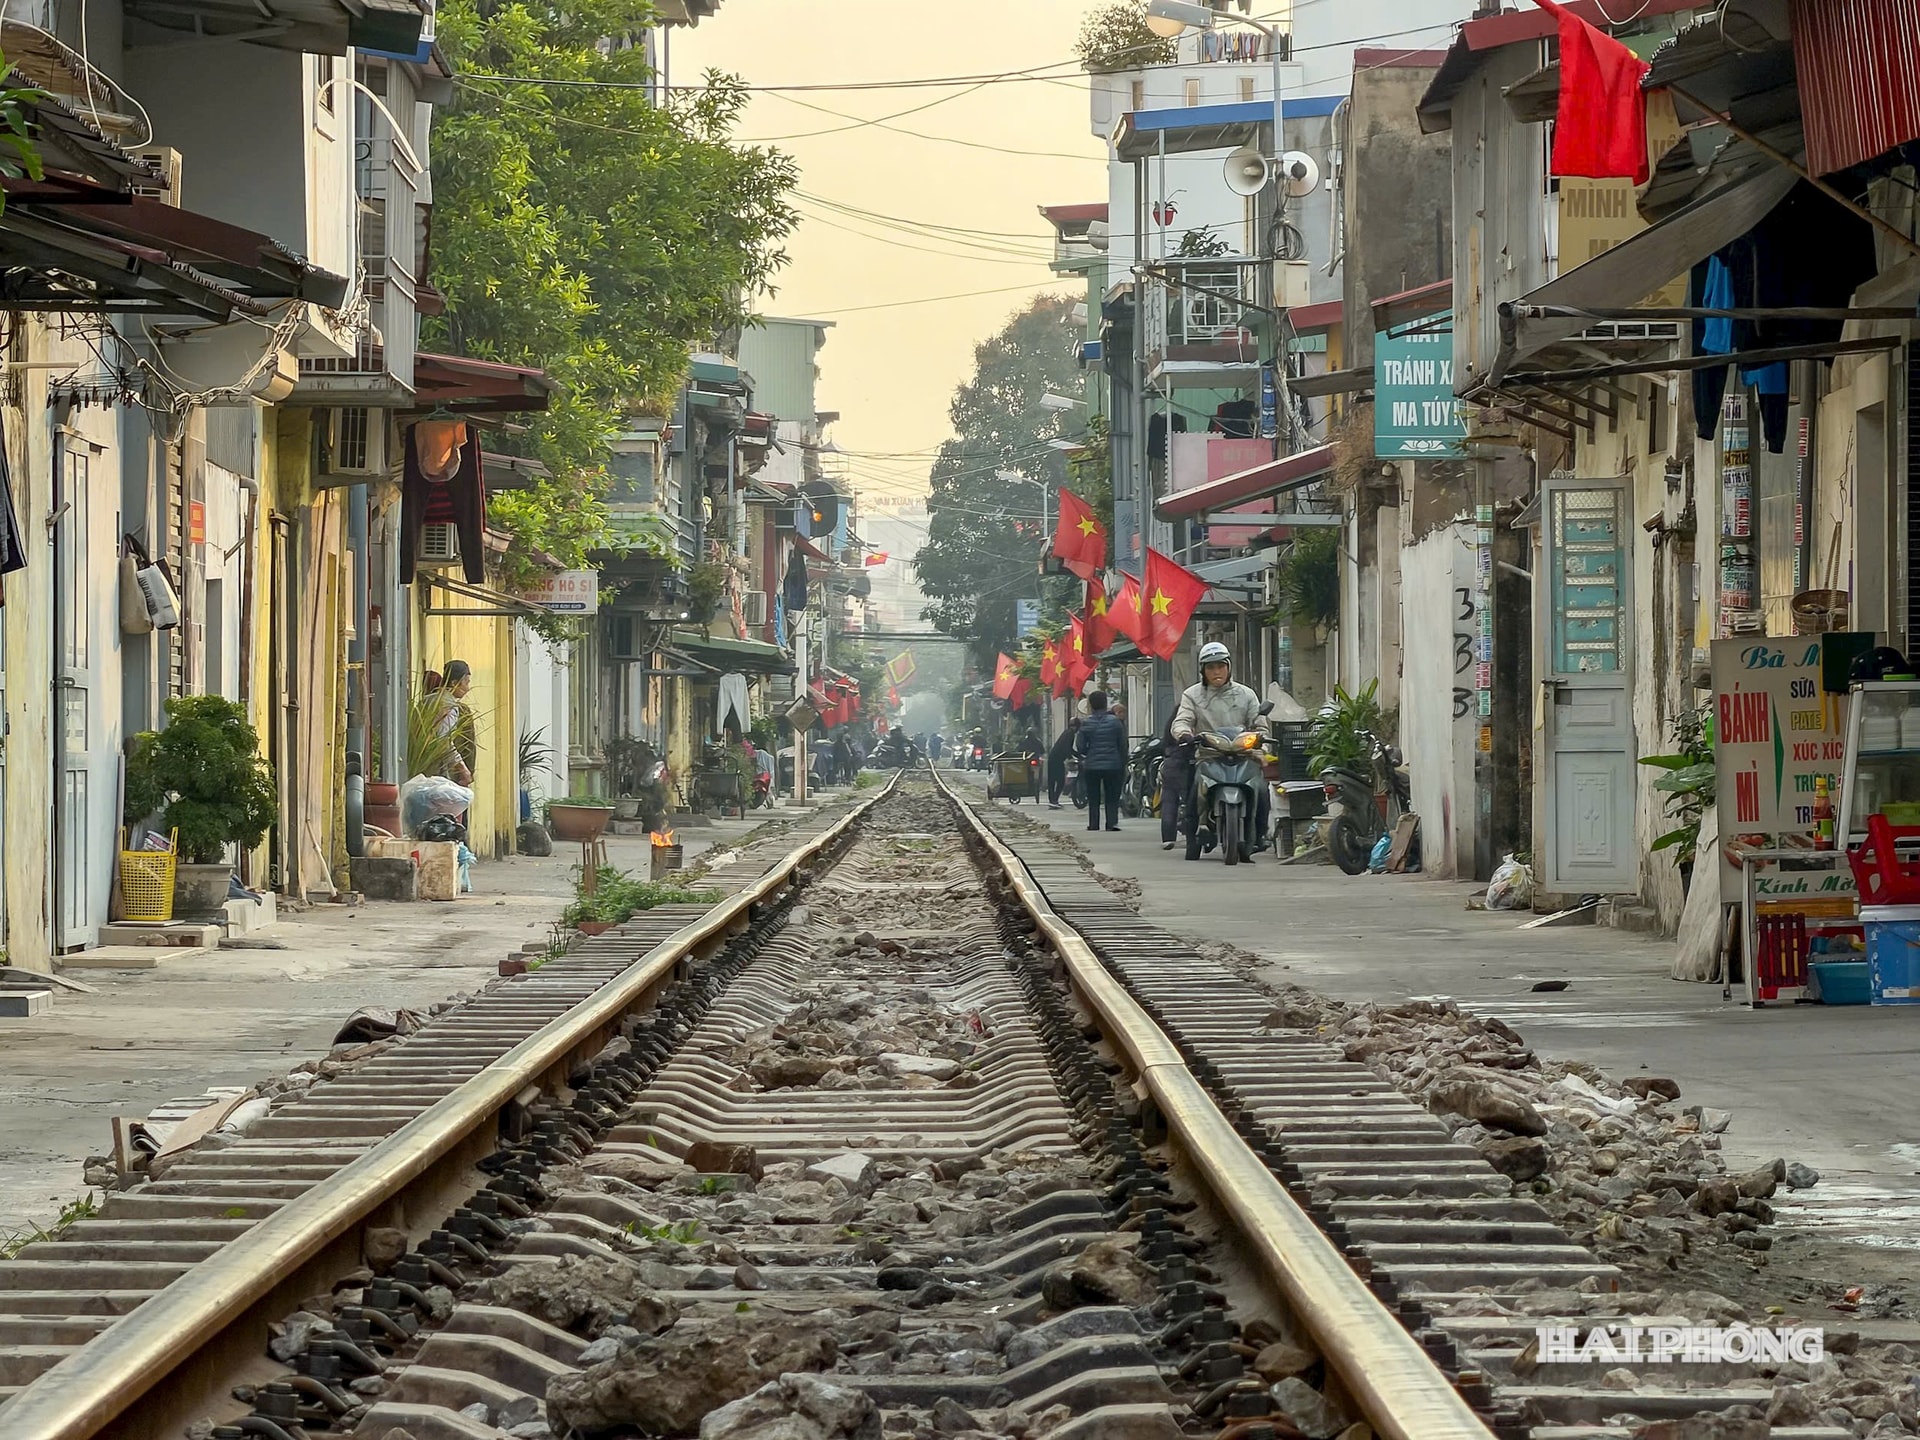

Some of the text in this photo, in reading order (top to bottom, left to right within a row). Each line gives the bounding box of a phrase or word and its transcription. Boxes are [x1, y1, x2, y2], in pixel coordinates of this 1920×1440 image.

[1384, 355, 1454, 385] TRÁNH X
[1393, 396, 1459, 427] MA TÚY!
[1741, 643, 1821, 669] Bà M
[1791, 677, 1815, 698] SỮA
[1719, 682, 1770, 744] BÁNH
[1791, 710, 1822, 730] PATE
[1793, 740, 1818, 761] XÚC
[1736, 760, 1760, 823] MÌ
